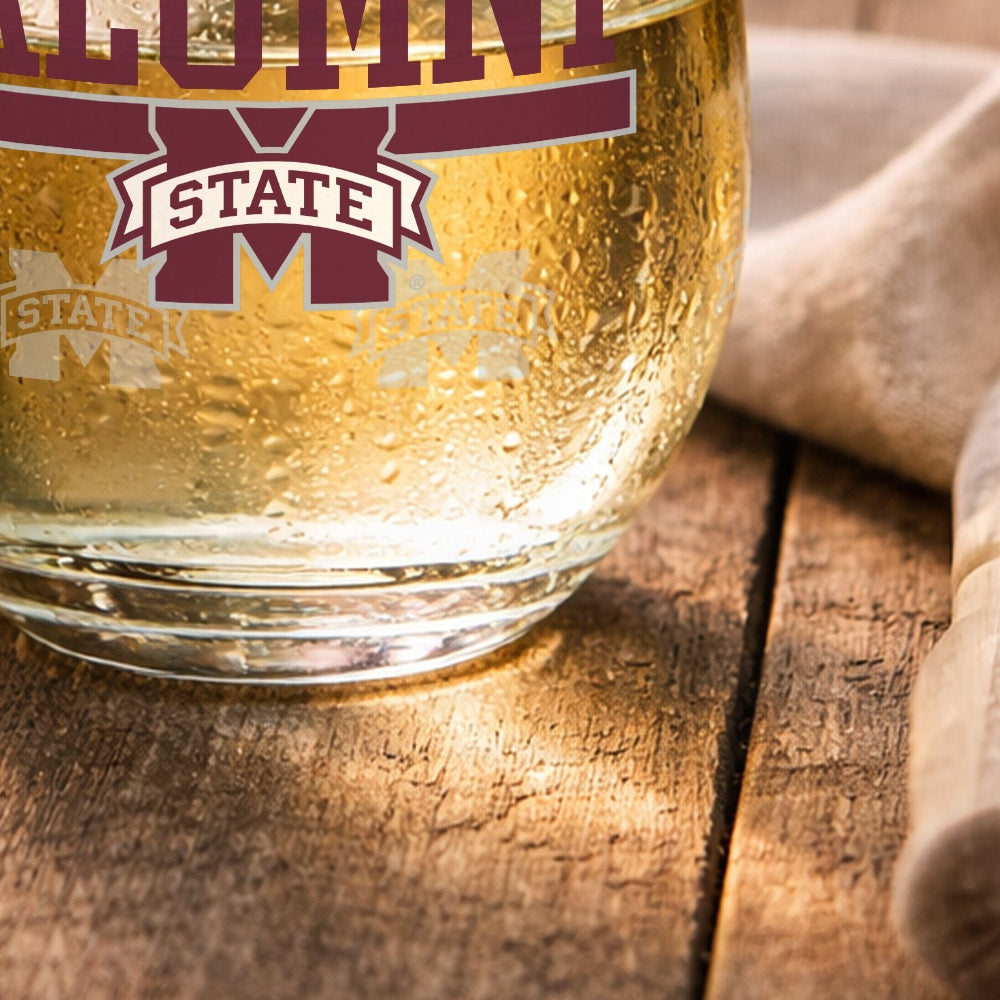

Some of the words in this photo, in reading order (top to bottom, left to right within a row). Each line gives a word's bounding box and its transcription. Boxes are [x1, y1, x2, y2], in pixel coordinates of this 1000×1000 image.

[170, 169, 373, 232] STATE
[18, 294, 150, 342] STATE
[386, 295, 519, 340] STATE
